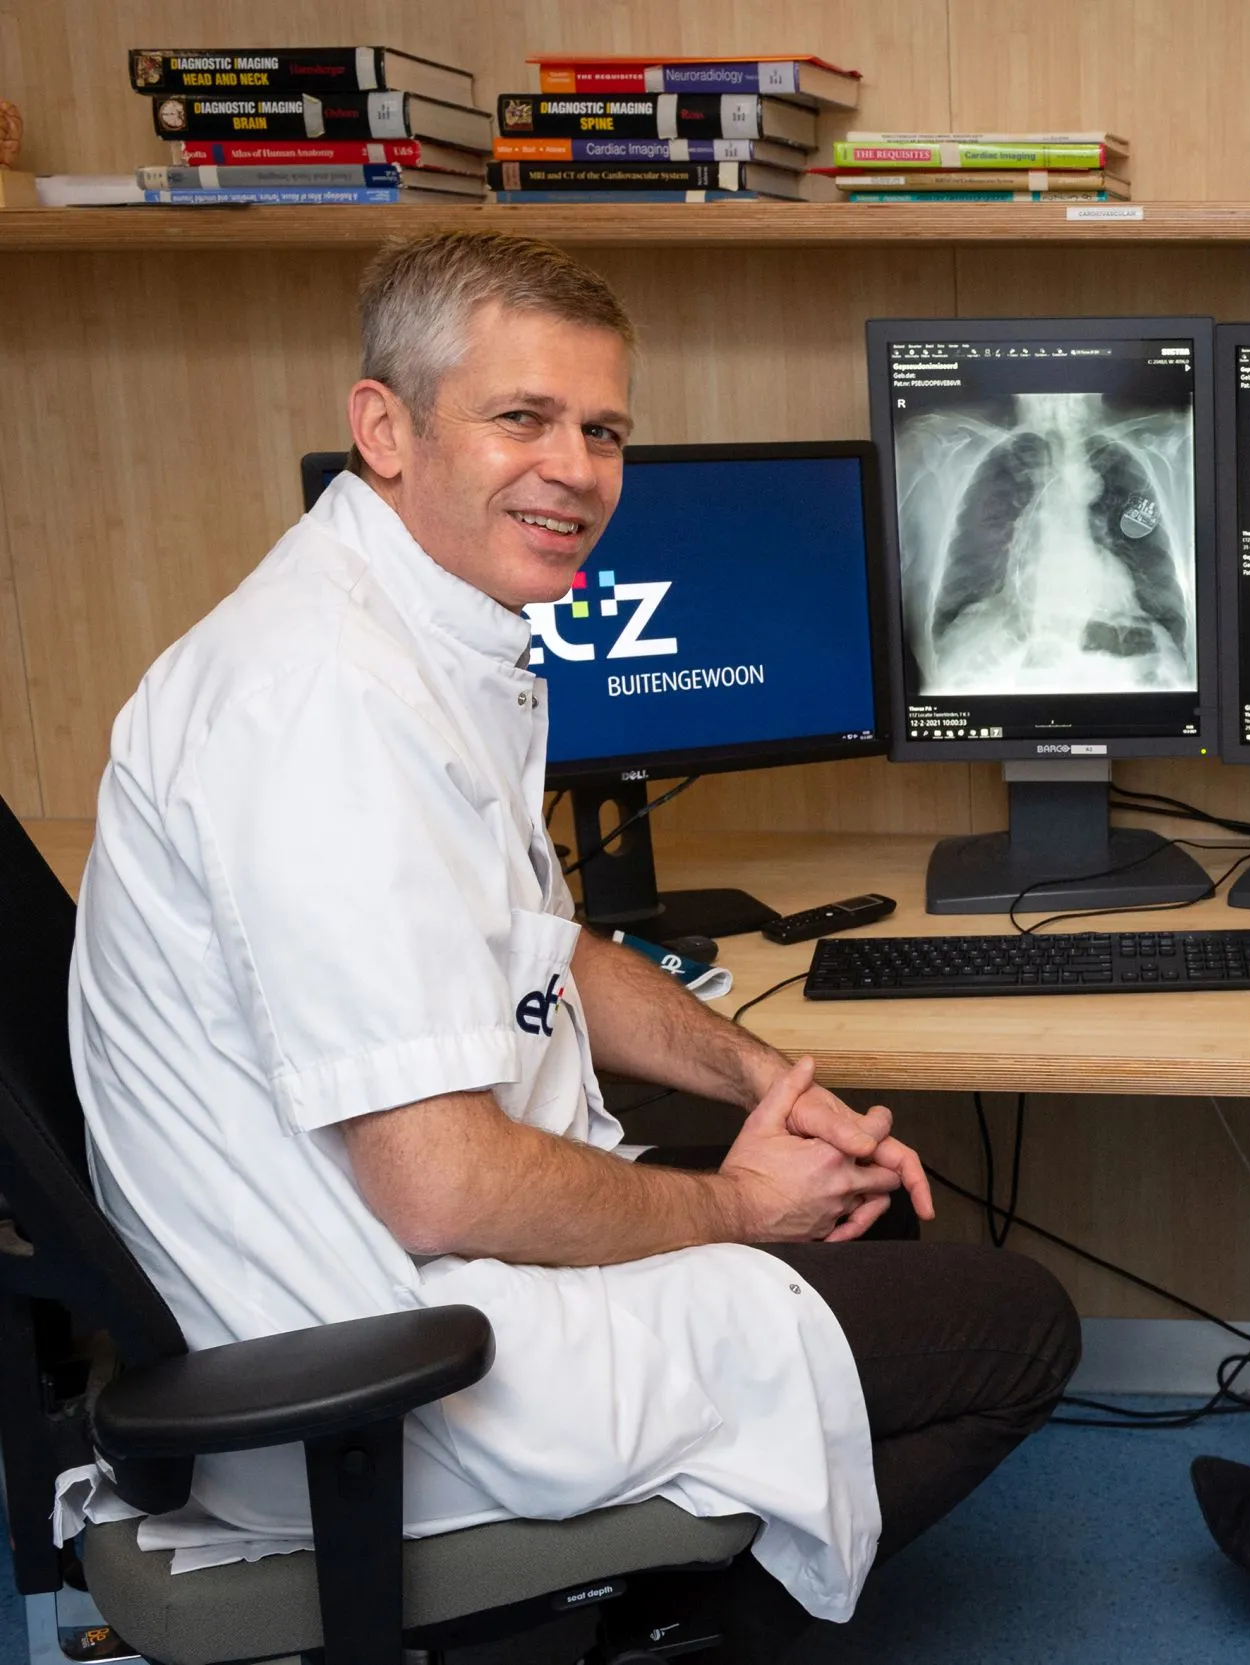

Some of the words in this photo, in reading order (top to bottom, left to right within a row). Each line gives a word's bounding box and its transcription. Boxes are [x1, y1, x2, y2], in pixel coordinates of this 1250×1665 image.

[171, 57, 232, 70] DIAGNOSTIC
[234, 57, 279, 70] IMAGING
[183, 73, 212, 86] HEAD
[215, 73, 238, 86] AND
[240, 73, 270, 86] NECK
[666, 68, 744, 84] Neuroradiology
[194, 101, 255, 114] DIAGNOSTIC
[258, 101, 303, 114] IMAGING
[540, 102, 604, 115] DIAGNOSTIC
[606, 102, 653, 115] IMAGING
[233, 117, 267, 130] BRAIN
[580, 117, 614, 131] SPINE
[232, 148, 251, 158] Atlas
[253, 148, 262, 158] of
[263, 148, 295, 158] Human
[297, 148, 334, 159] Anatomy
[586, 142, 626, 156] Cardiac
[629, 143, 669, 158] Imaging
[856, 150, 876, 158] THE
[877, 150, 930, 160] REQUISITES
[999, 152, 1036, 161] Imaging
[529, 171, 545, 180] MRI
[547, 171, 561, 180] and
[563, 171, 575, 180] CT
[577, 171, 586, 180] of
[587, 171, 600, 180] the
[602, 171, 659, 180] Cardiovascular
[661, 171, 689, 182] System
[897, 398, 906, 408] R
[608, 665, 764, 696] BUITENGEWOON
[910, 719, 940, 727] 12-2-2021
[1037, 745, 1071, 753] BARCO
[567, 1592, 586, 1603] seat
[587, 1585, 613, 1599] depth
